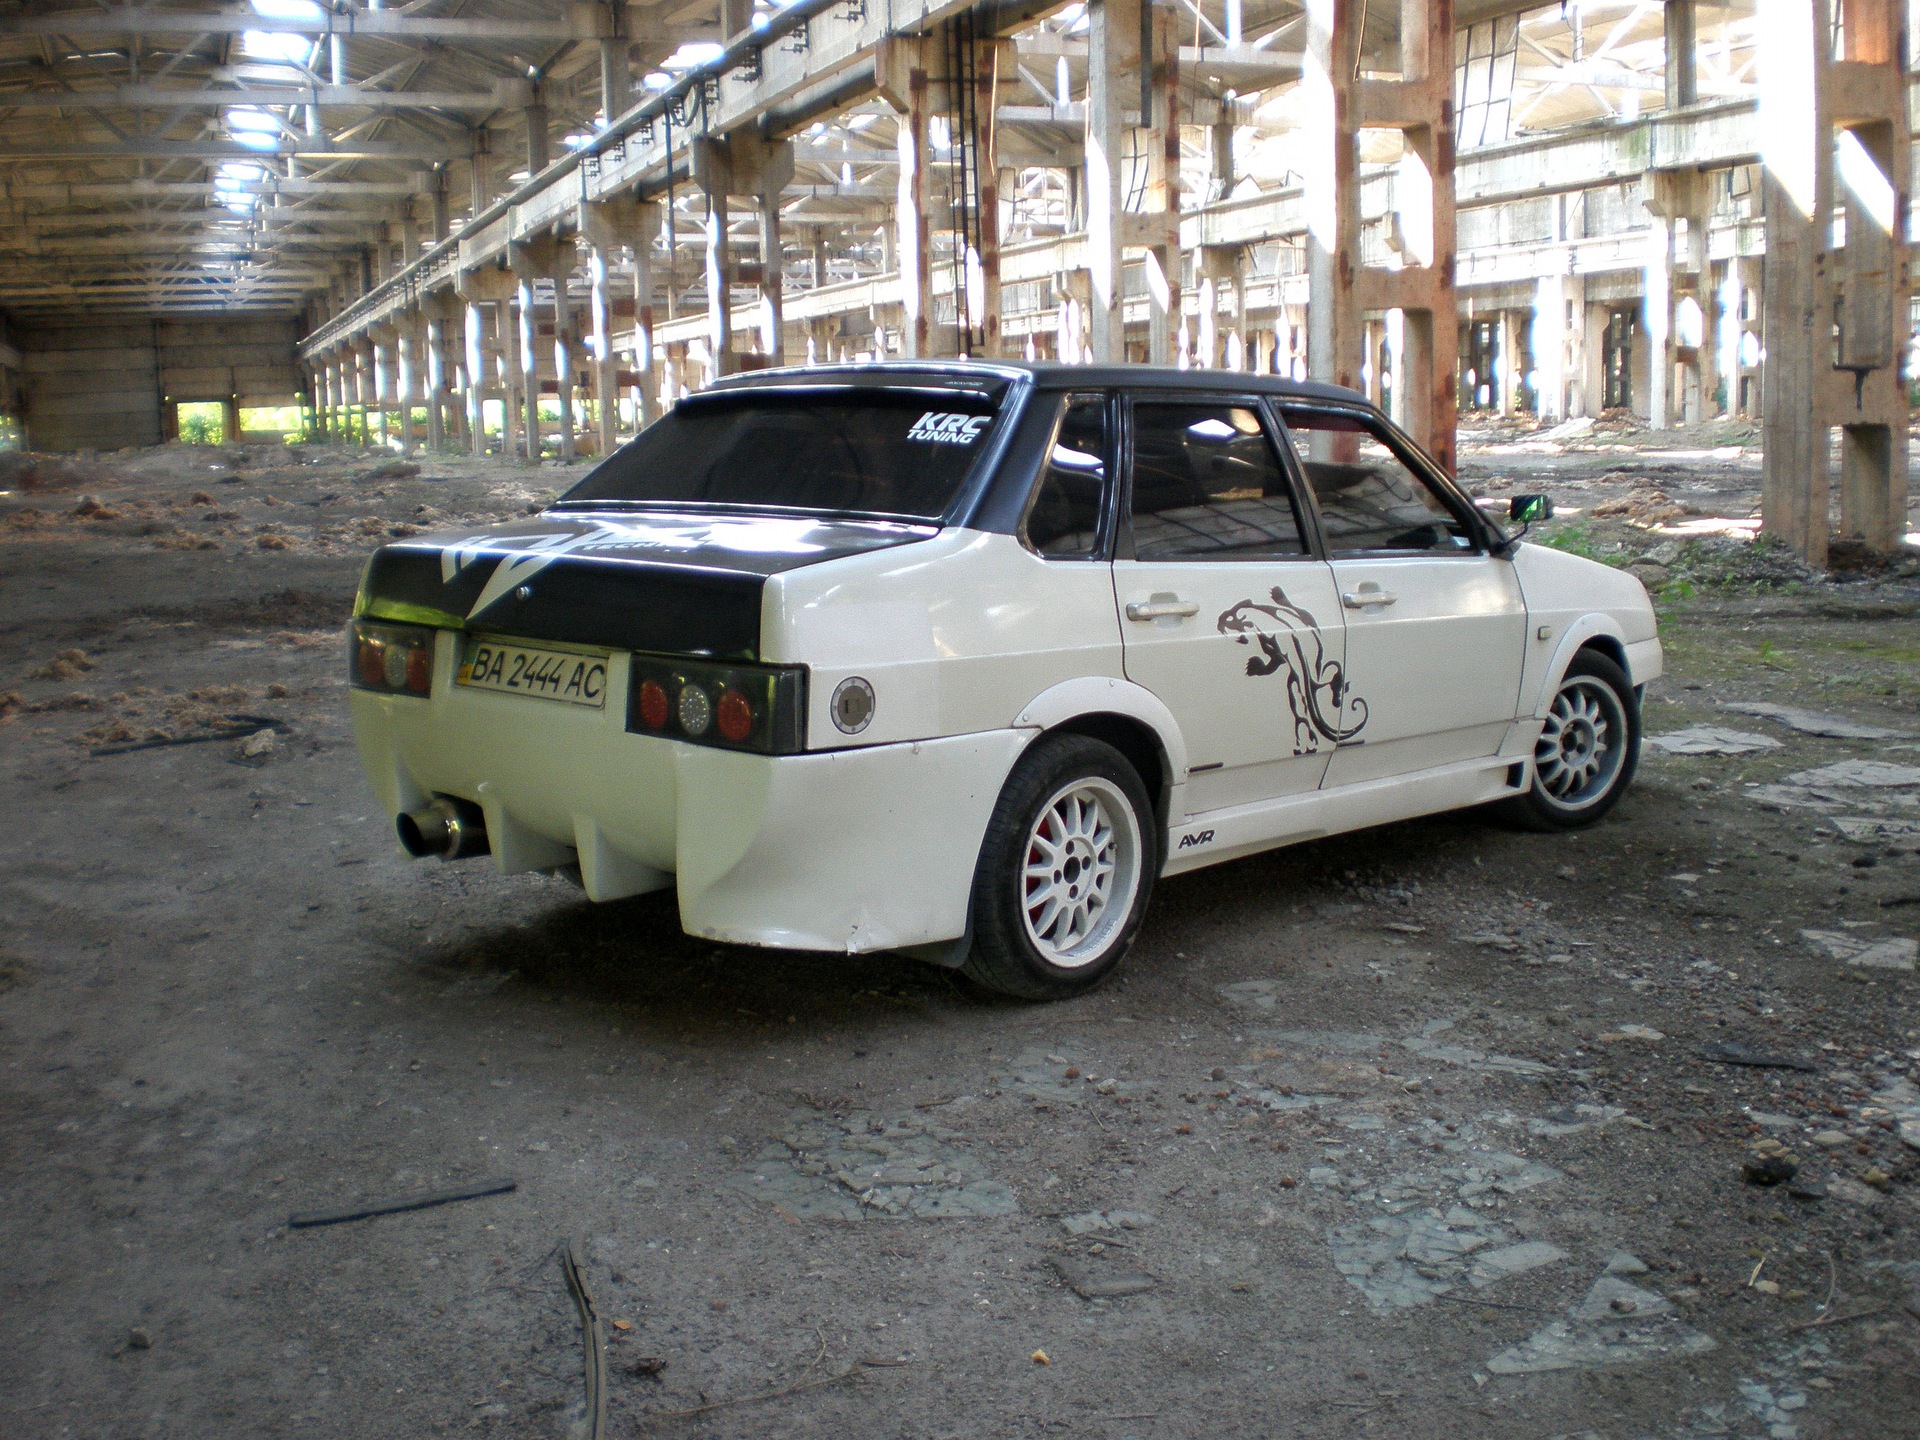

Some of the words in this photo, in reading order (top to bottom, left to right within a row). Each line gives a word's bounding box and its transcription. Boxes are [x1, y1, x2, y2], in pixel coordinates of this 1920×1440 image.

[912, 411, 992, 434] KRC
[907, 429, 976, 443] TUNING
[471, 648, 506, 684] BA
[507, 653, 566, 693] 2444
[564, 661, 605, 698] AC
[1178, 829, 1215, 849] AVR
